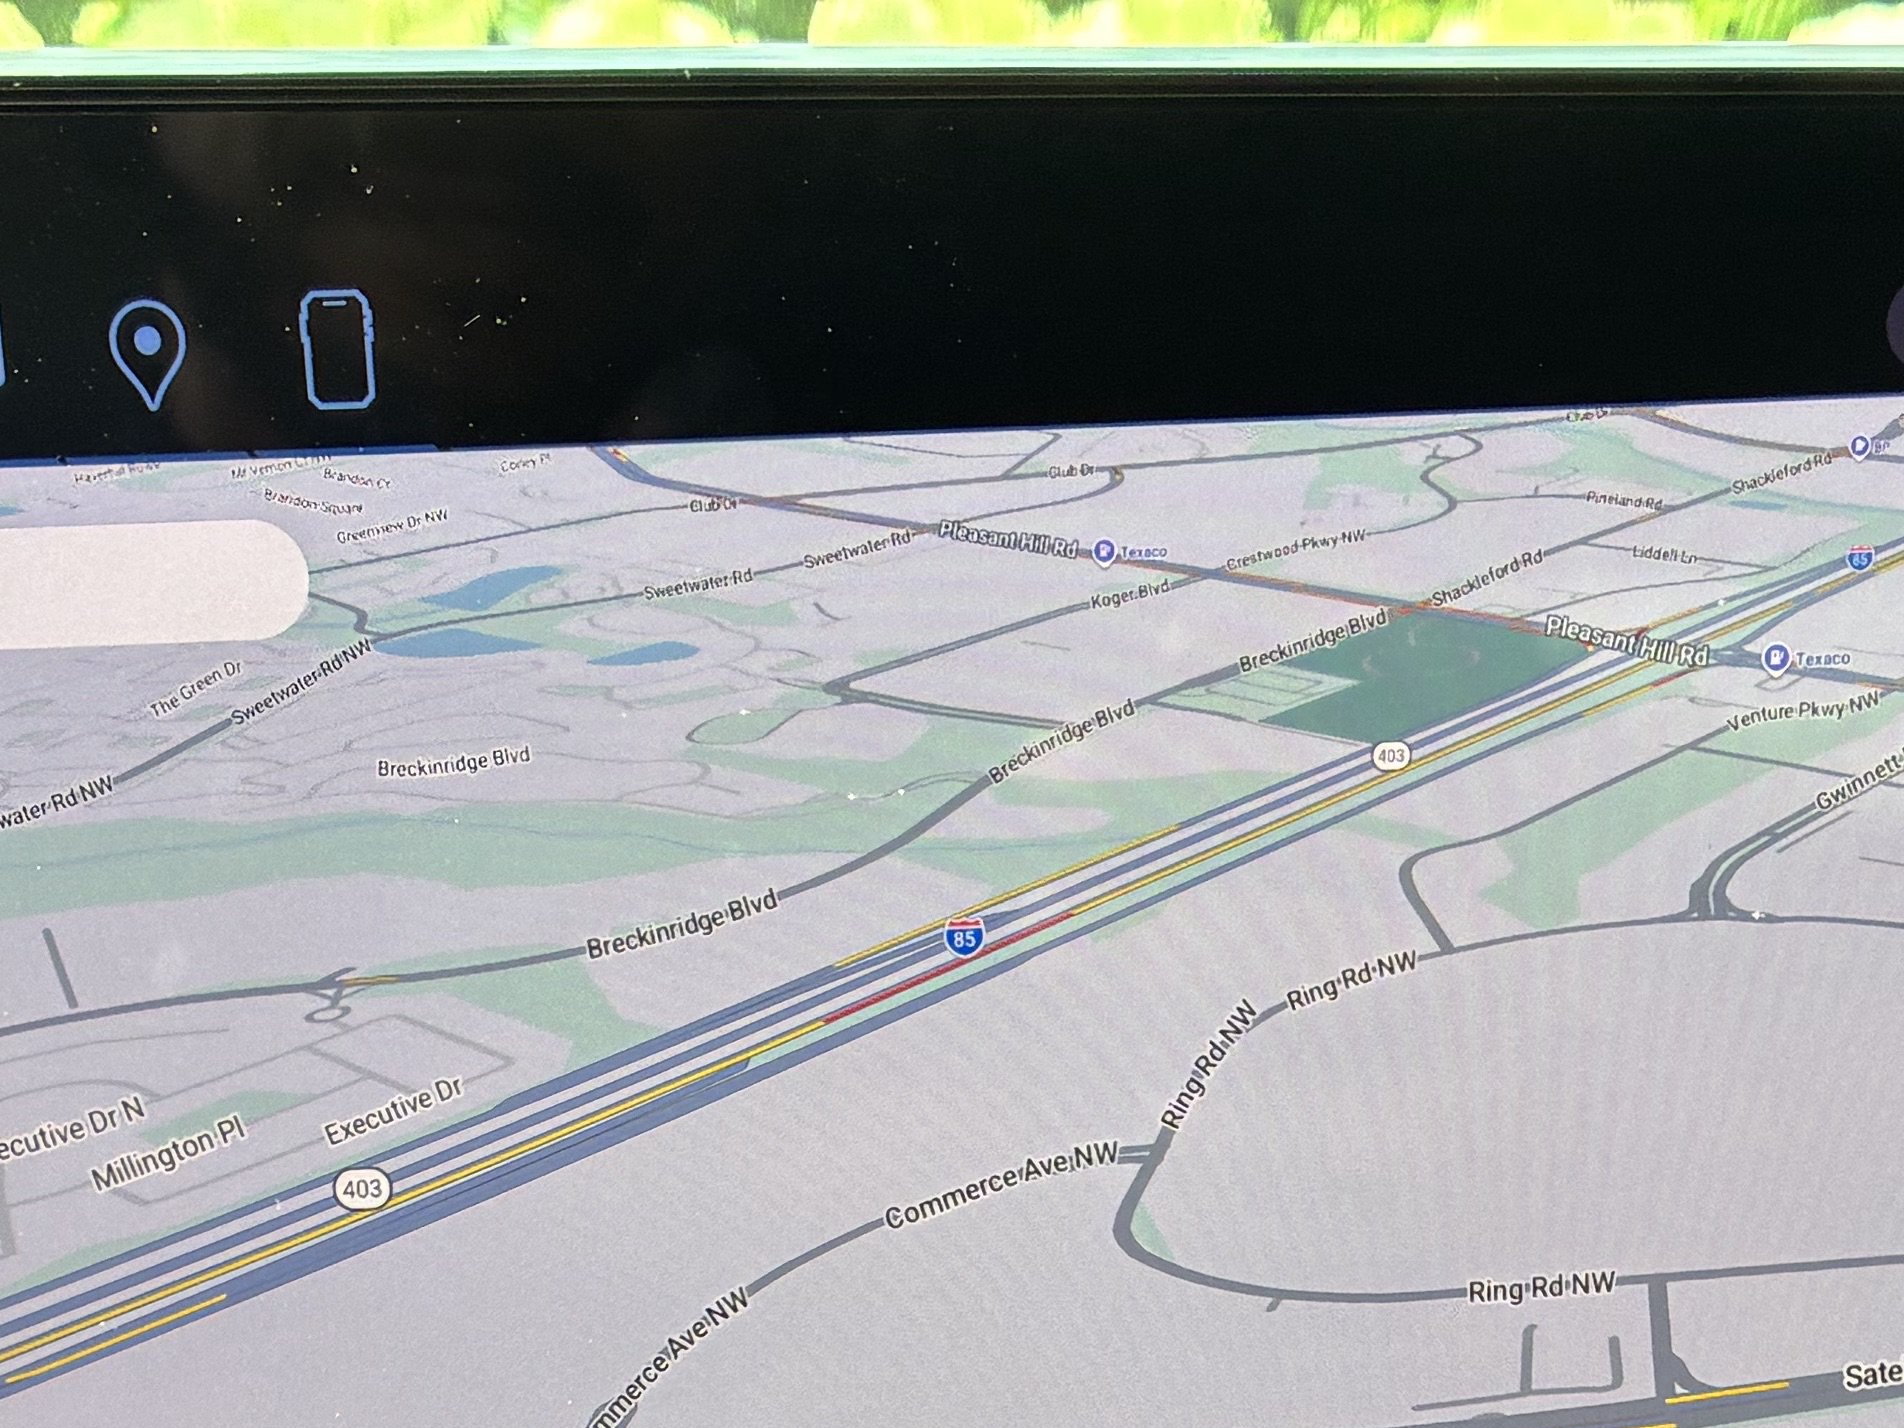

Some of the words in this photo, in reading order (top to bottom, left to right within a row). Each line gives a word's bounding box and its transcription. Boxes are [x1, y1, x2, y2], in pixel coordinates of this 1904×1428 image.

[1049, 464, 1077, 479] Club
[1732, 457, 1813, 494] Shackleford
[1813, 451, 1833, 468] Rd
[1586, 490, 1640, 508] Pineland
[1643, 497, 1664, 511] Rd
[803, 538, 889, 569] Sweetwater
[890, 528, 911, 548] Rd
[938, 521, 1017, 549] Pleasant
[1019, 532, 1052, 555] Hill
[1052, 538, 1079, 559] Rd
[1121, 544, 1168, 560] Texaco
[1226, 541, 1299, 573] Crestwood
[1301, 534, 1339, 555] Pkwy
[1342, 528, 1367, 545] NW
[1633, 545, 1678, 562] Liddell
[1852, 553, 1869, 567] 85
[644, 573, 731, 601] Sweetwater
[732, 567, 753, 585] Rd
[1091, 587, 1134, 609] Koger
[1138, 578, 1170, 598] Blvd
[1431, 558, 1521, 608] Shackleford
[1521, 548, 1545, 568] Rd
[1239, 623, 1348, 674] Breckinridge
[1349, 607, 1388, 637] Blvd
[1544, 615, 1640, 657] Pleasant
[1641, 637, 1678, 664] Hill
[1678, 642, 1710, 667] Rd
[1796, 650, 1850, 667] Texaco
[150, 695, 179, 719] The
[179, 673, 223, 701] Green
[224, 660, 243, 679] Dr
[231, 670, 319, 726] Sweetwater
[320, 654, 343, 677] Rd
[342, 639, 372, 664] NW
[1727, 703, 1794, 732] Venture
[1798, 700, 1847, 721] Pkwy
[1849, 690, 1880, 711] NW
[989, 719, 1096, 785] Breckinridge
[1094, 697, 1136, 731] Blvd
[1377, 746, 1405, 763] 403
[378, 750, 489, 778] Breckinridge
[492, 746, 531, 766] Blvd
[51, 787, 78, 812] Rd
[79, 774, 114, 803] NW
[1815, 755, 1903, 811] Gwinnett
[587, 908, 725, 959] Breckinridge
[728, 888, 778, 921] Blvd
[953, 928, 976, 949] 85
[1287, 979, 1339, 1010] Ring
[1340, 962, 1372, 989] Rd
[1377, 950, 1417, 977] NW
[1161, 1079, 1206, 1130] Ring
[1194, 1040, 1227, 1077] Rd
[1219, 998, 1257, 1045] NW
[88, 1105, 120, 1134] Dr
[123, 1096, 146, 1122] N
[324, 1091, 434, 1147] Executive
[435, 1076, 464, 1102] Dr
[91, 1133, 214, 1193] Millington
[217, 1115, 246, 1145] Pl
[342, 1178, 384, 1199] 403
[885, 1170, 1018, 1230] Commerce
[1022, 1152, 1070, 1182] Ave
[1073, 1140, 1120, 1170] NW
[1469, 1278, 1524, 1305] Ring
[1532, 1273, 1567, 1298] Rd
[1571, 1270, 1617, 1294] NW
[667, 1316, 708, 1359] Ave
[707, 1286, 751, 1328] NW
